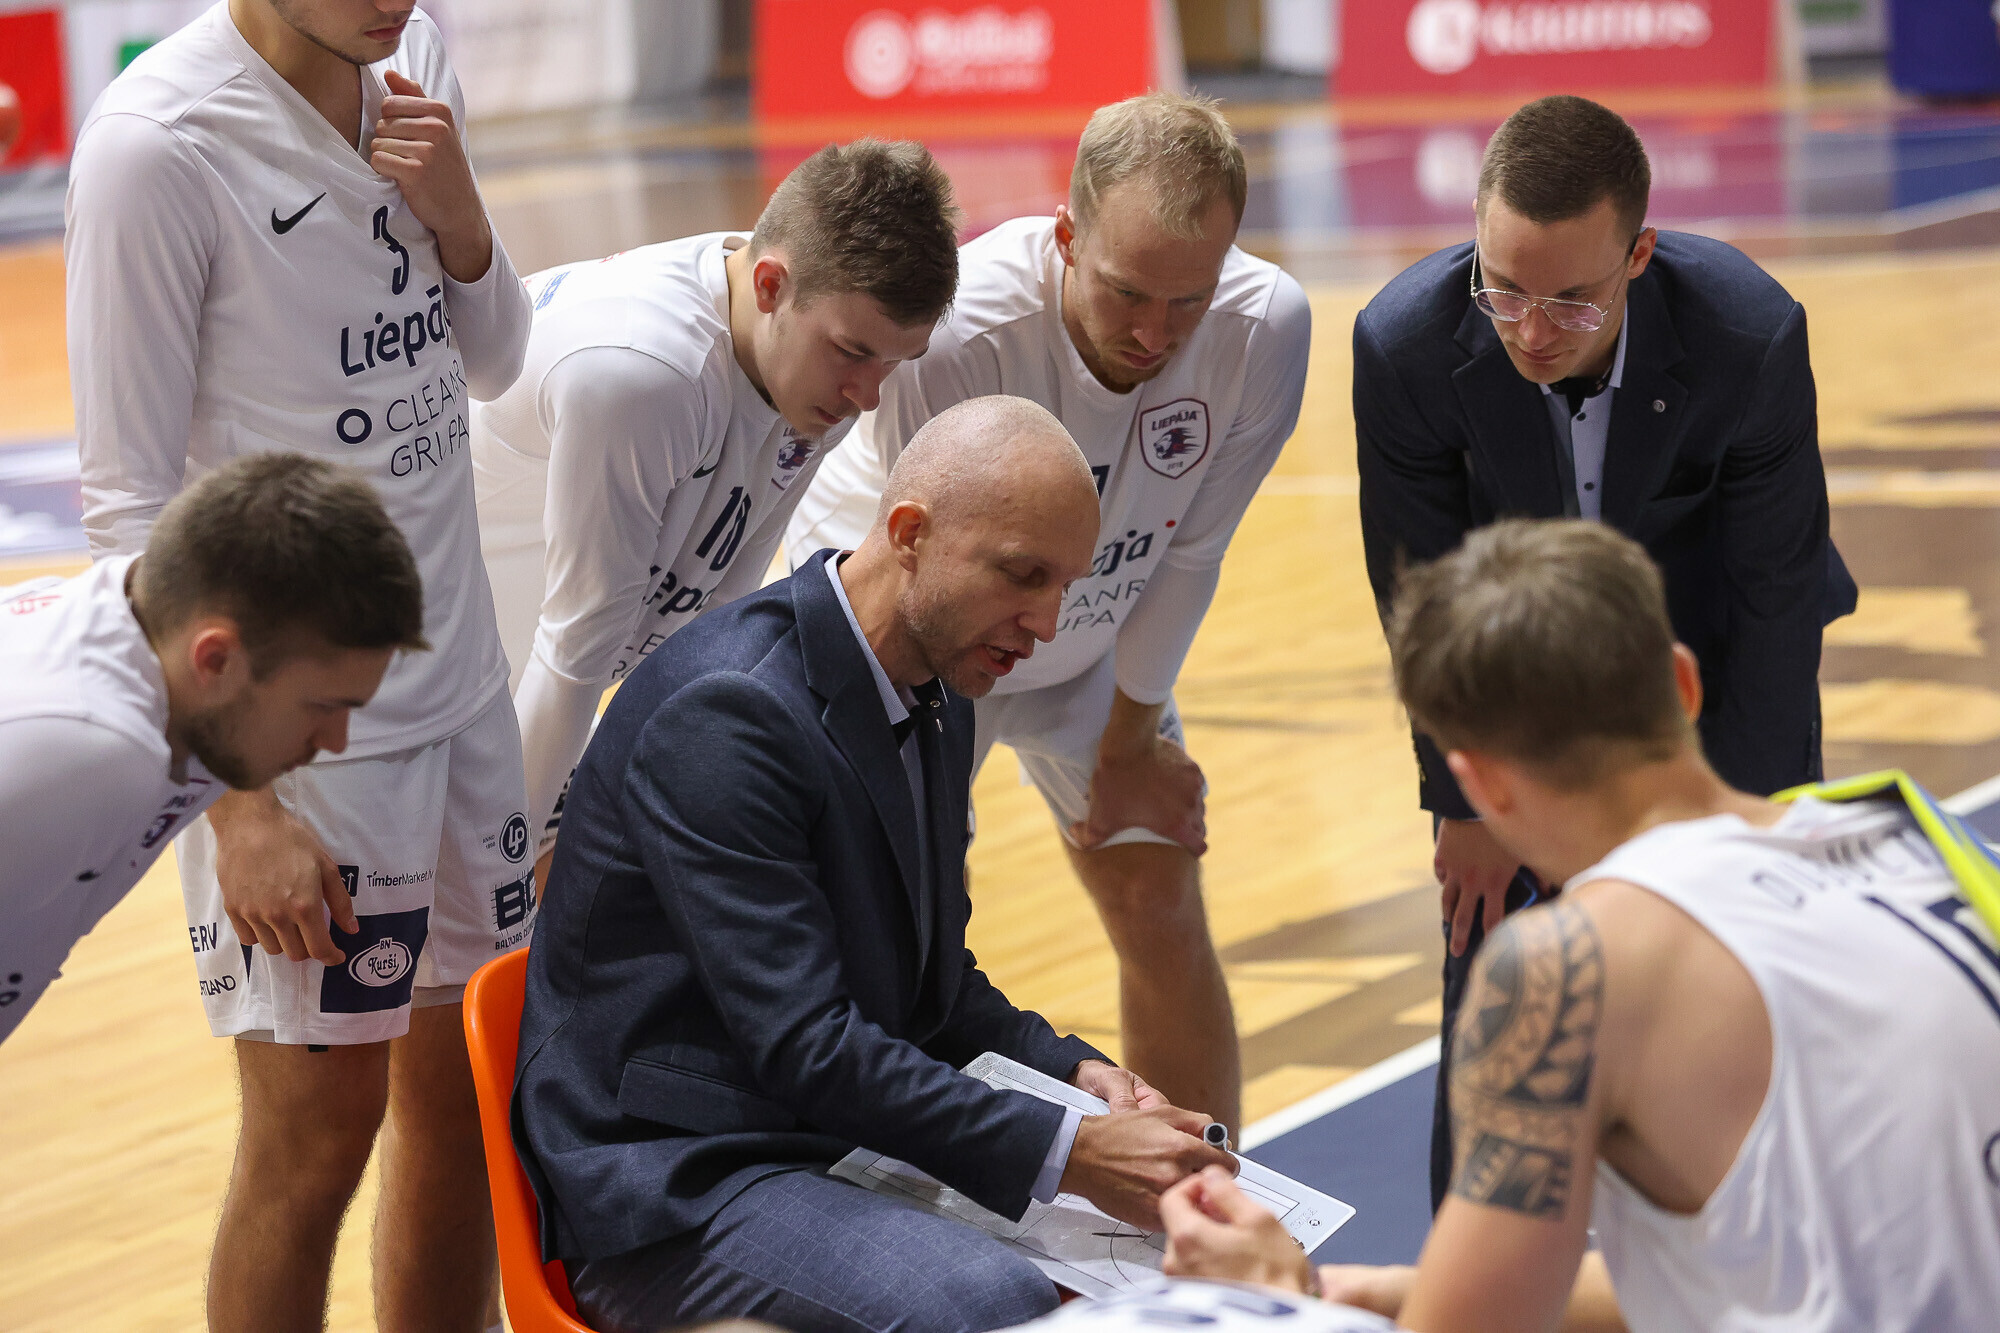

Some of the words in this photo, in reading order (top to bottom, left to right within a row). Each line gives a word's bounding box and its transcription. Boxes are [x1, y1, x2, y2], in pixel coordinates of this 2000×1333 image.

[372, 205, 410, 295] 3
[695, 486, 752, 571] 10
[189, 921, 217, 952] ERV
[380, 940, 391, 950] BN
[368, 953, 399, 977] Kurši
